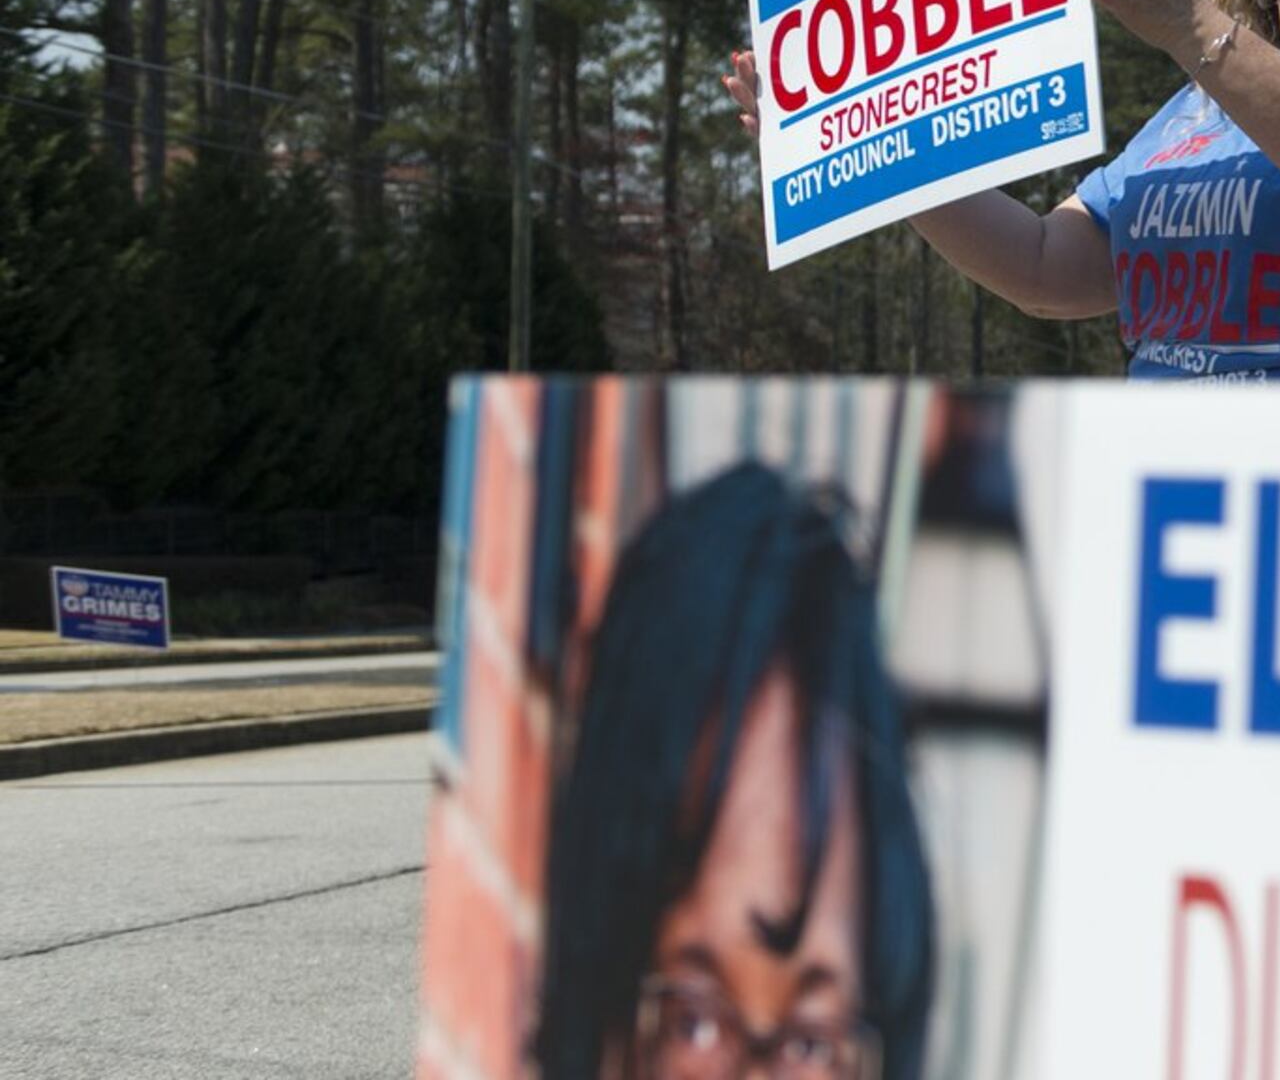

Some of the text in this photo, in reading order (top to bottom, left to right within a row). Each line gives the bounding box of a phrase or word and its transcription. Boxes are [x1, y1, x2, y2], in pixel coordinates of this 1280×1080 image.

[785, 168, 823, 208] CITY
[828, 131, 915, 189] COUNCIL
[931, 82, 1042, 147] DISTRICT
[1048, 75, 1067, 108] 3
[819, 50, 997, 152] STONECREST
[1129, 177, 1262, 239] JAZZMIN
[63, 596, 160, 622] GRIMES
